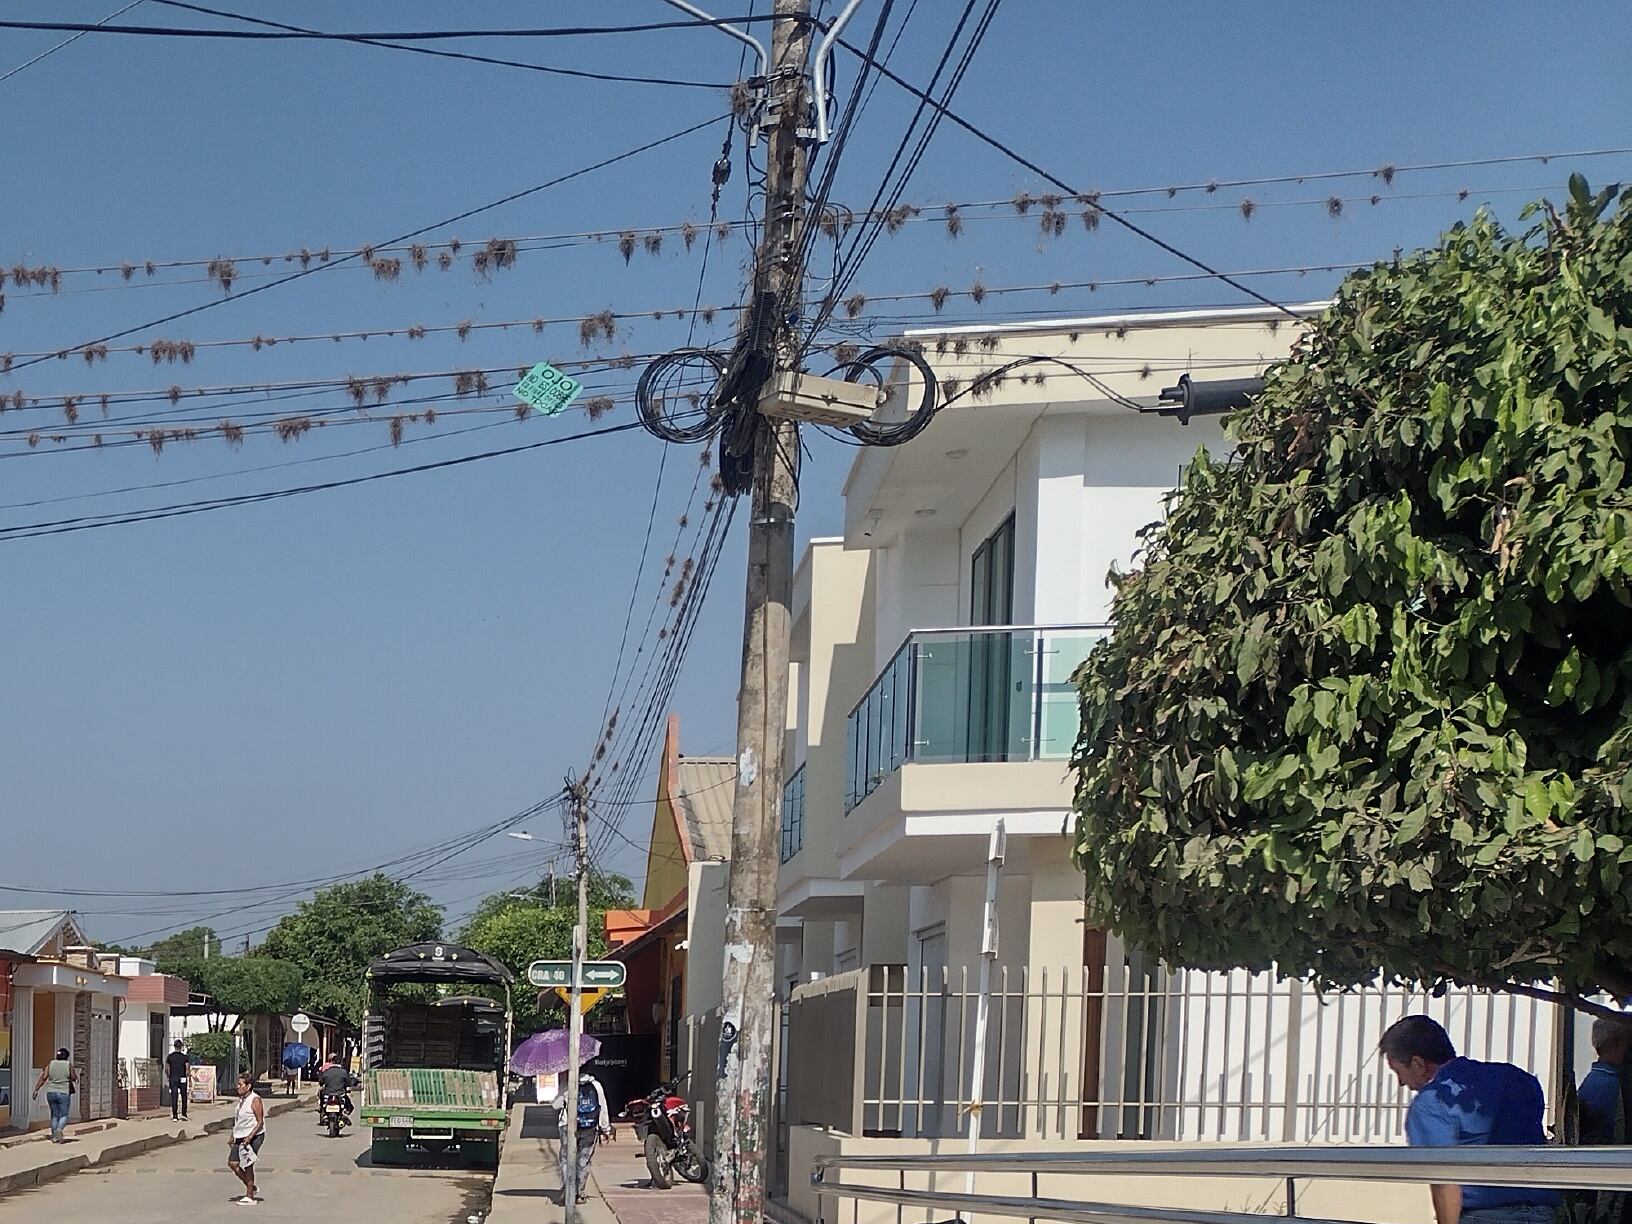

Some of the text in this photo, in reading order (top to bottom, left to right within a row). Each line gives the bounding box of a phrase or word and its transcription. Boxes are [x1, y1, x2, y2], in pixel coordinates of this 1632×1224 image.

[542, 369, 573, 391] OJO
[515, 386, 529, 397] NO
[531, 969, 550, 980] CRA
